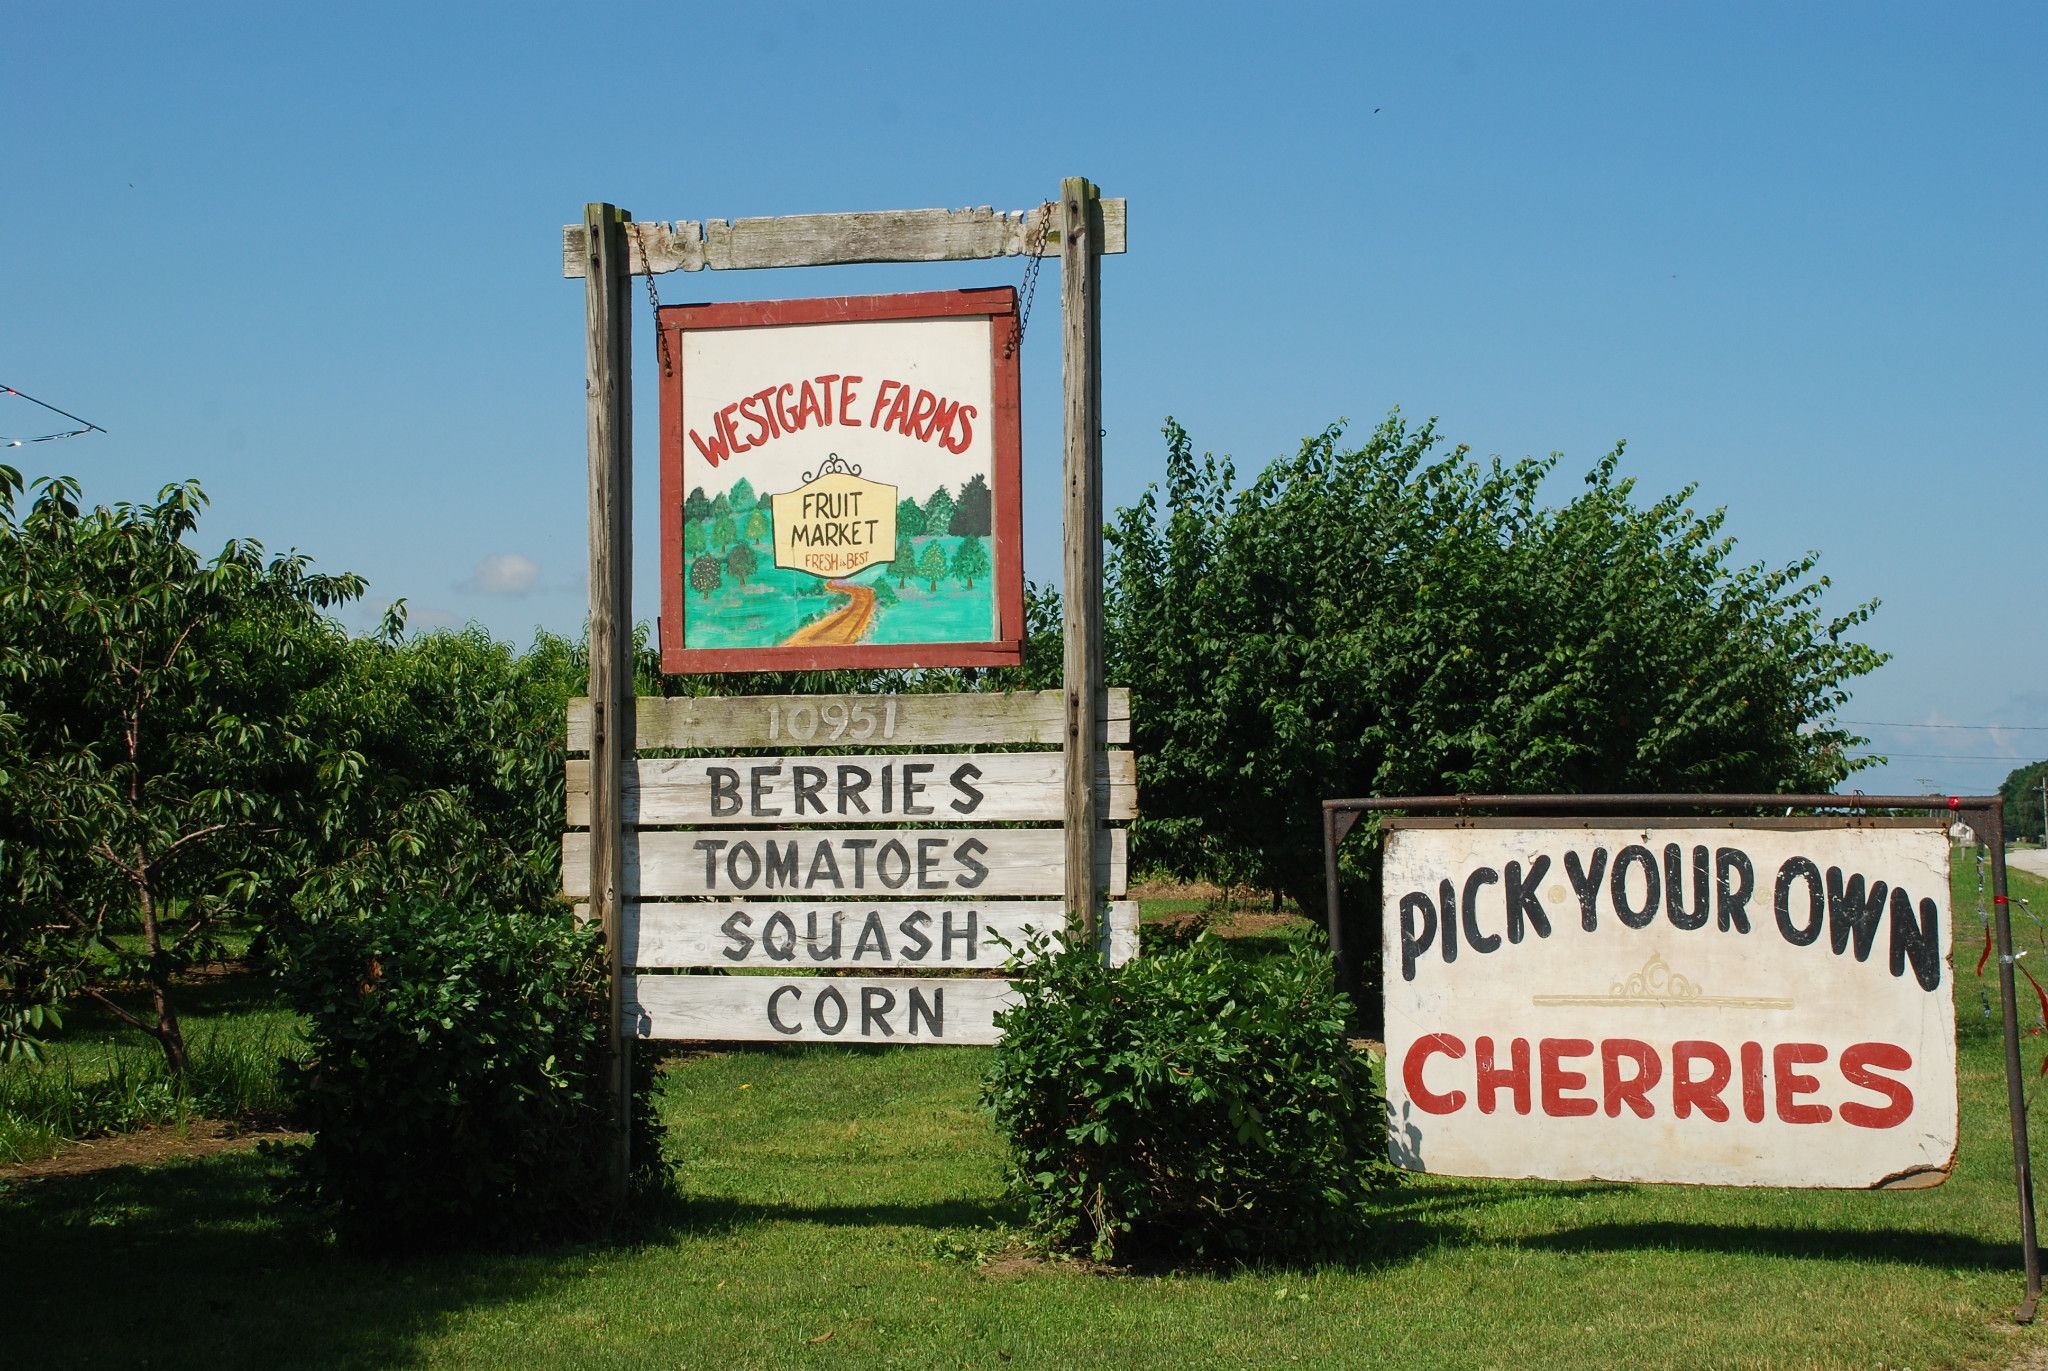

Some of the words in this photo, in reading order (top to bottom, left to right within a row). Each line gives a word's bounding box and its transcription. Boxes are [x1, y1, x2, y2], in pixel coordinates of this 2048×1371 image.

[689, 374, 863, 468] WESTGATE
[870, 380, 977, 454] FARMS
[803, 492, 863, 520] FRUIT
[792, 520, 879, 547] MARKET
[805, 553, 839, 570] FRESH
[846, 552, 869, 568] BEST
[769, 701, 897, 741] 10951
[707, 762, 984, 817] BERRIES
[693, 837, 990, 889] TOMATOES
[720, 910, 978, 962] SQUASH
[1400, 854, 1552, 982] PICK
[1564, 842, 1755, 934] YOUR
[1774, 856, 1941, 992] OWN
[767, 985, 944, 1038] CORN
[1402, 1033, 1914, 1129] CHERRIES
